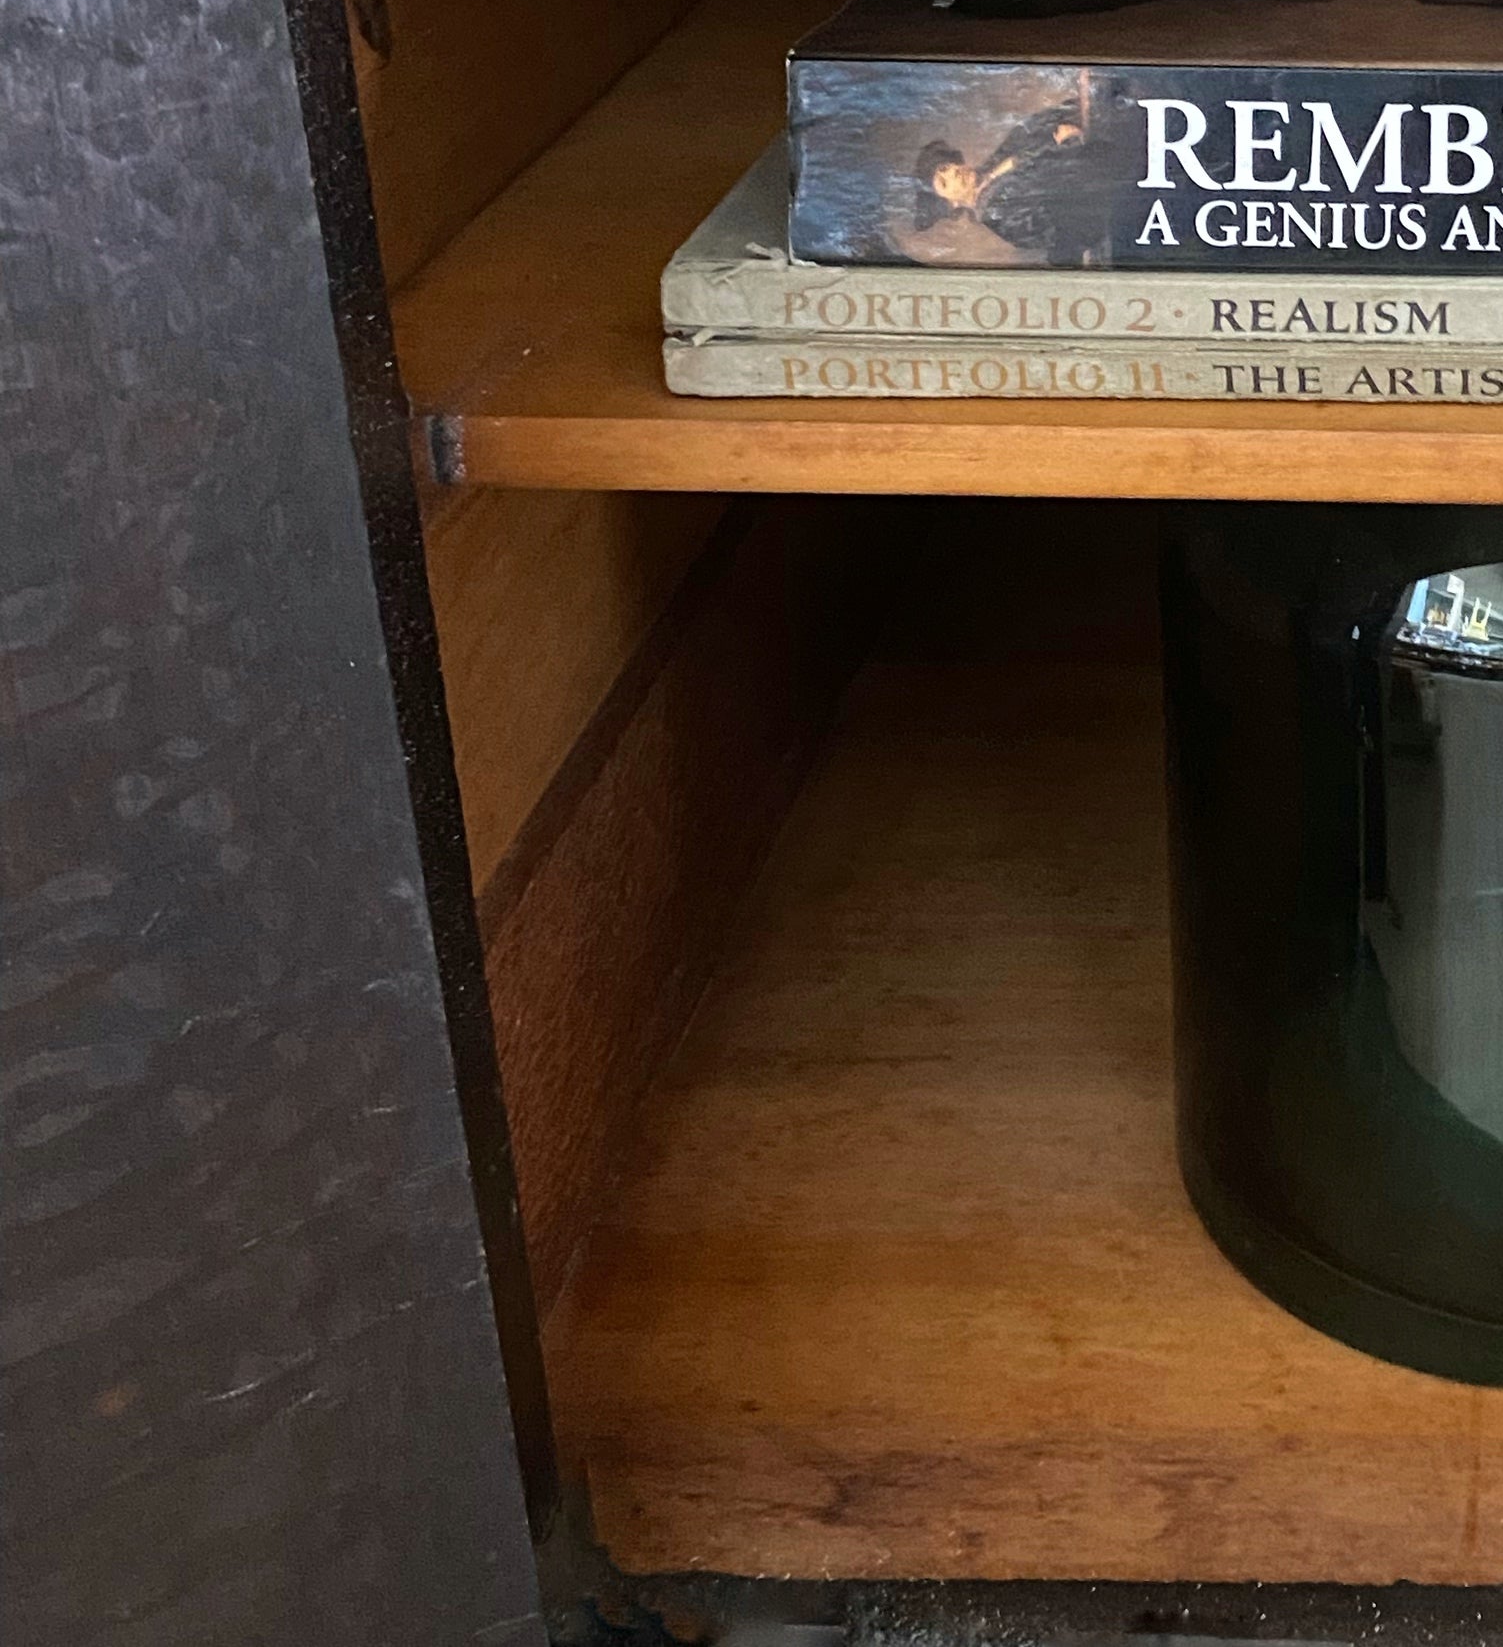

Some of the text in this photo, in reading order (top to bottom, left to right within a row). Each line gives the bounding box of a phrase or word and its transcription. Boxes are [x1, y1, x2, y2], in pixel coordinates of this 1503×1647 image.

[1135, 198, 1180, 247] A
[1194, 198, 1428, 252] GENIUS
[782, 290, 1452, 336] PORTFOLIO 2 REALISM
[781, 356, 1107, 394] PORTFOLIO
[1214, 363, 1326, 396] THE
